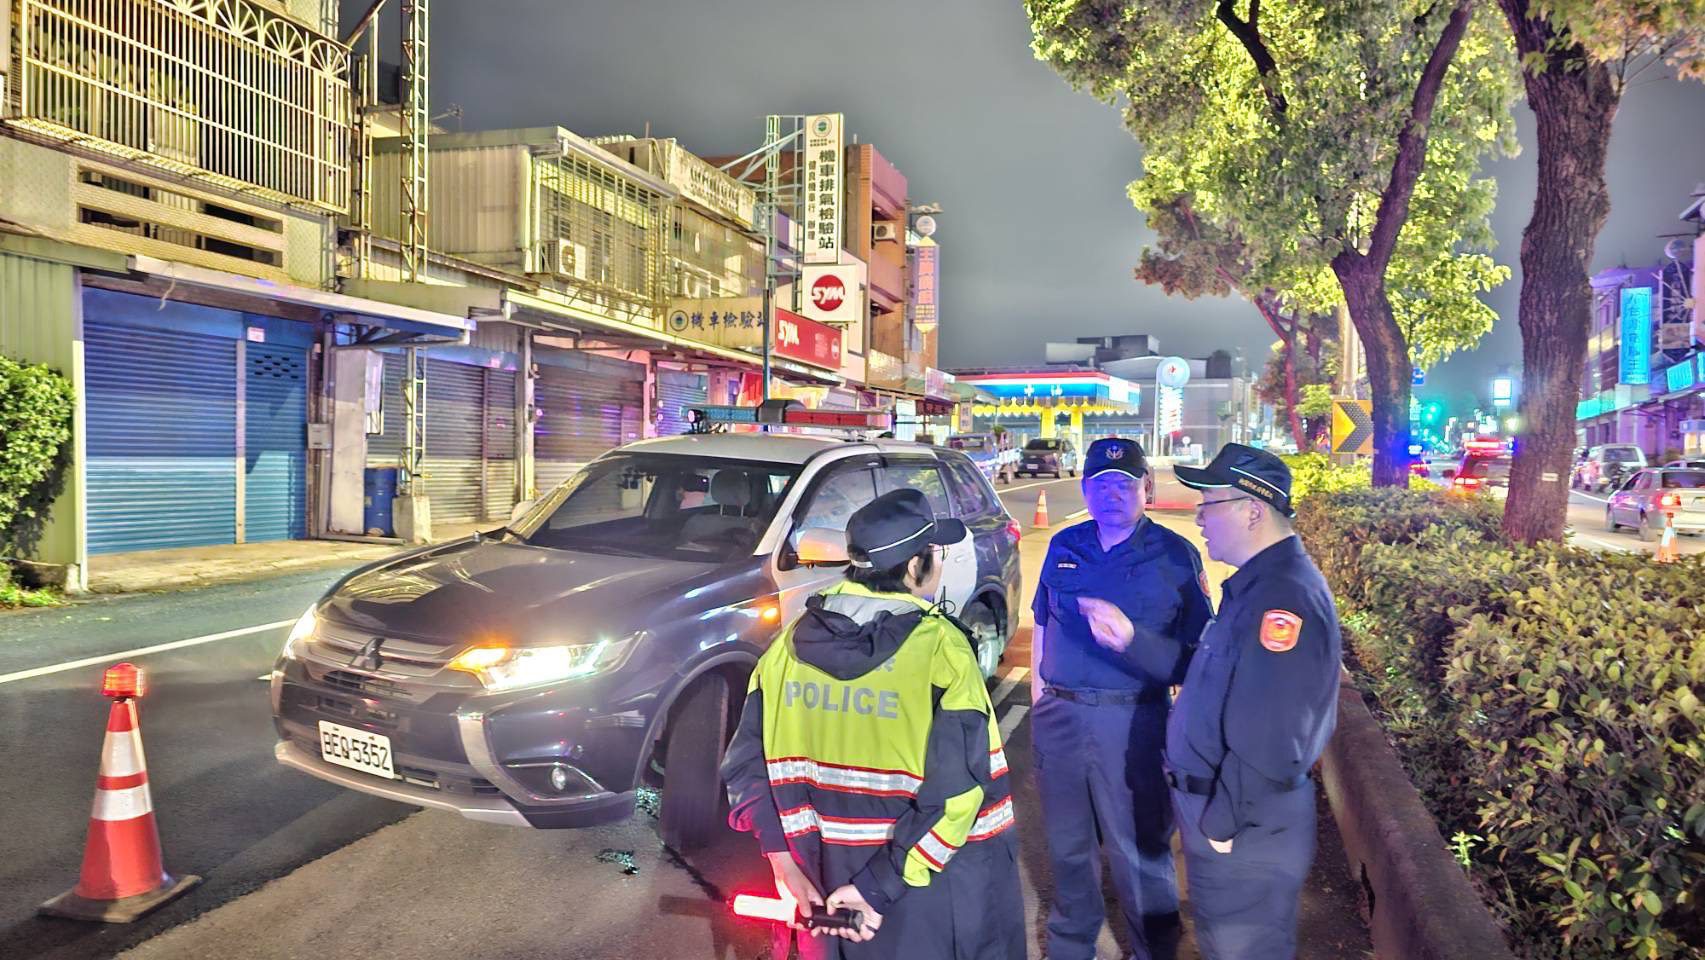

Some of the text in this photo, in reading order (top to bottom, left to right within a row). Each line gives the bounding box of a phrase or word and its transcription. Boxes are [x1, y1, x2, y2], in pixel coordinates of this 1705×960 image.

[819, 149, 835, 249] 機車排氣檢驗站
[811, 286, 845, 304] SYM
[778, 319, 800, 347] SYM
[784, 681, 899, 719] POLICE
